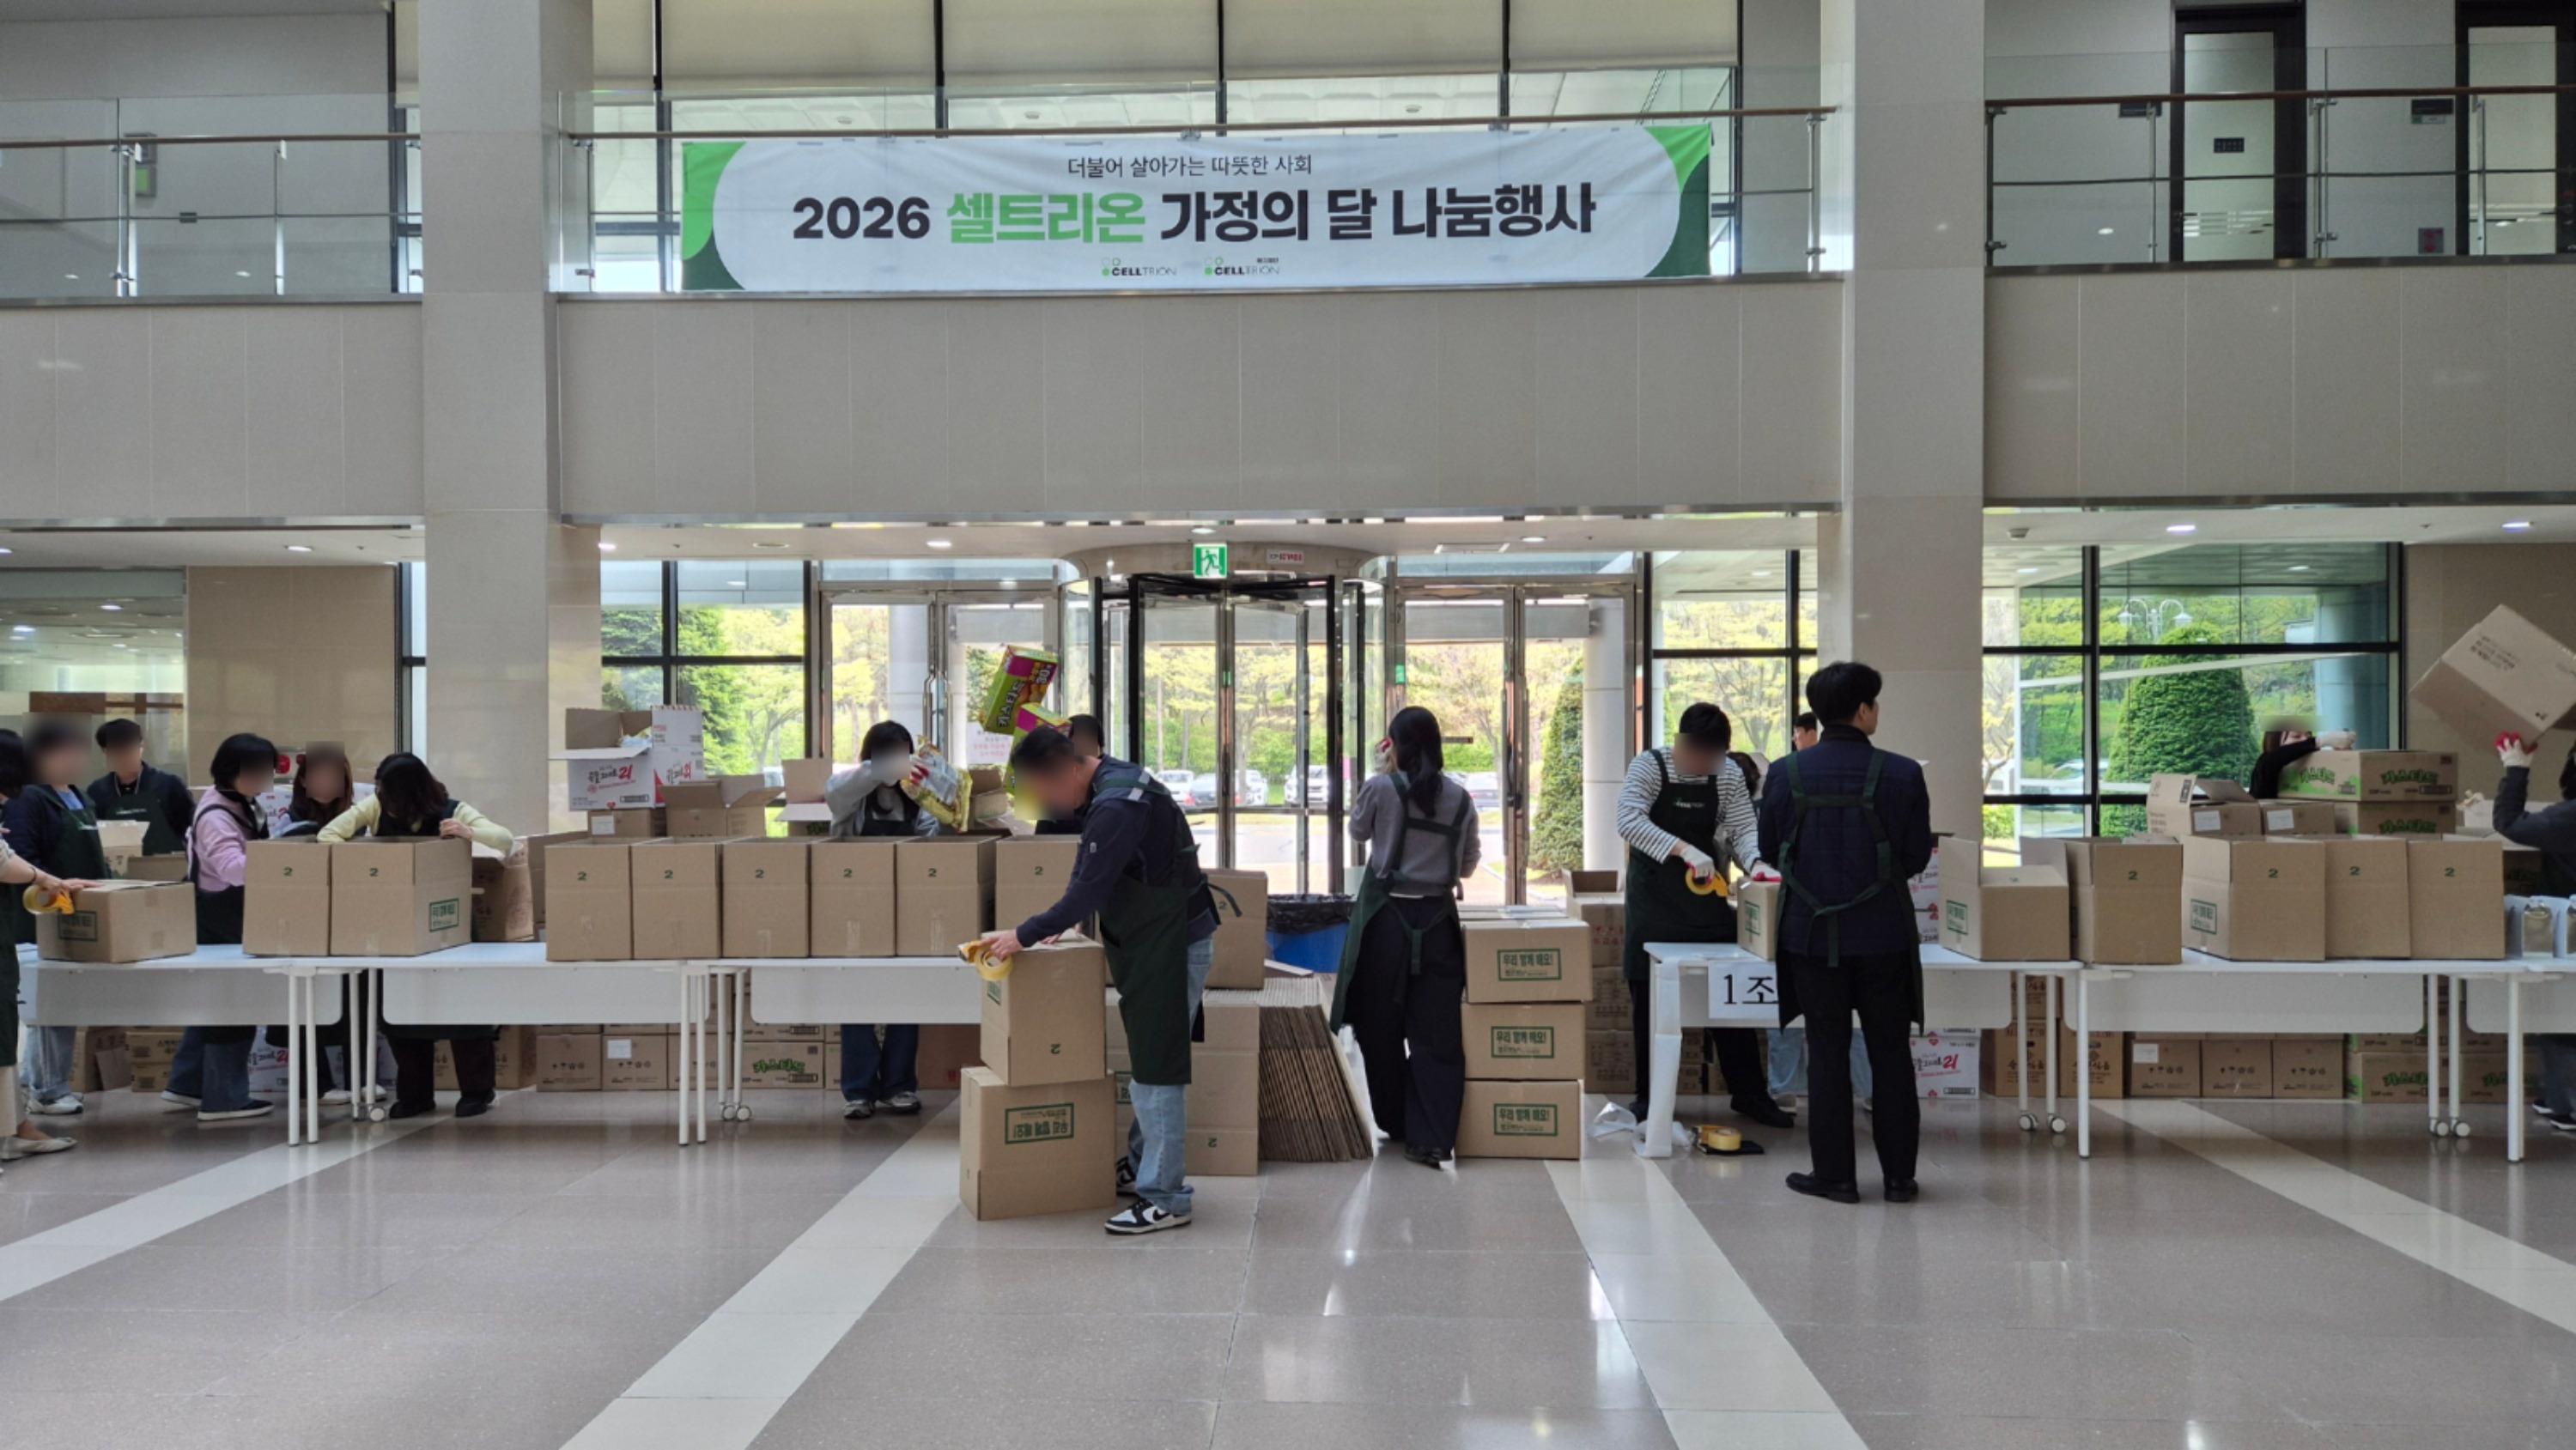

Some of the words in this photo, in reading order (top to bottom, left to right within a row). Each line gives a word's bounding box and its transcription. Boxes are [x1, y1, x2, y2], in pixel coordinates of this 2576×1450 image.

[1067, 155, 1123, 179] 더불어
[1130, 155, 1206, 178] 살아가는
[1212, 155, 1268, 176] 따뜻한
[1274, 154, 1312, 175] 사회
[793, 197, 931, 240] 2026
[946, 191, 1146, 244] 셀트리온
[1160, 188, 1309, 242] 가정의
[1327, 188, 1377, 240] 달
[1392, 181, 1596, 239] 나눔행사
[1111, 267, 1177, 276] CELLTRION
[997, 679, 1025, 729] 카스타드
[283, 866, 294, 877] 2
[369, 867, 380, 877] 2
[664, 869, 674, 879] 2
[755, 869, 765, 879] 2
[842, 867, 853, 878] 2
[927, 867, 938, 877] 2
[1034, 865, 1044, 876] 2
[2268, 868, 2279, 878] 2
[2349, 866, 2360, 877] 2
[2445, 867, 2455, 877] 2
[577, 871, 587, 881] 2
[2128, 871, 2138, 881] 2
[1050, 1043, 1061, 1054] 2
[1207, 1137, 1218, 1148] 2
